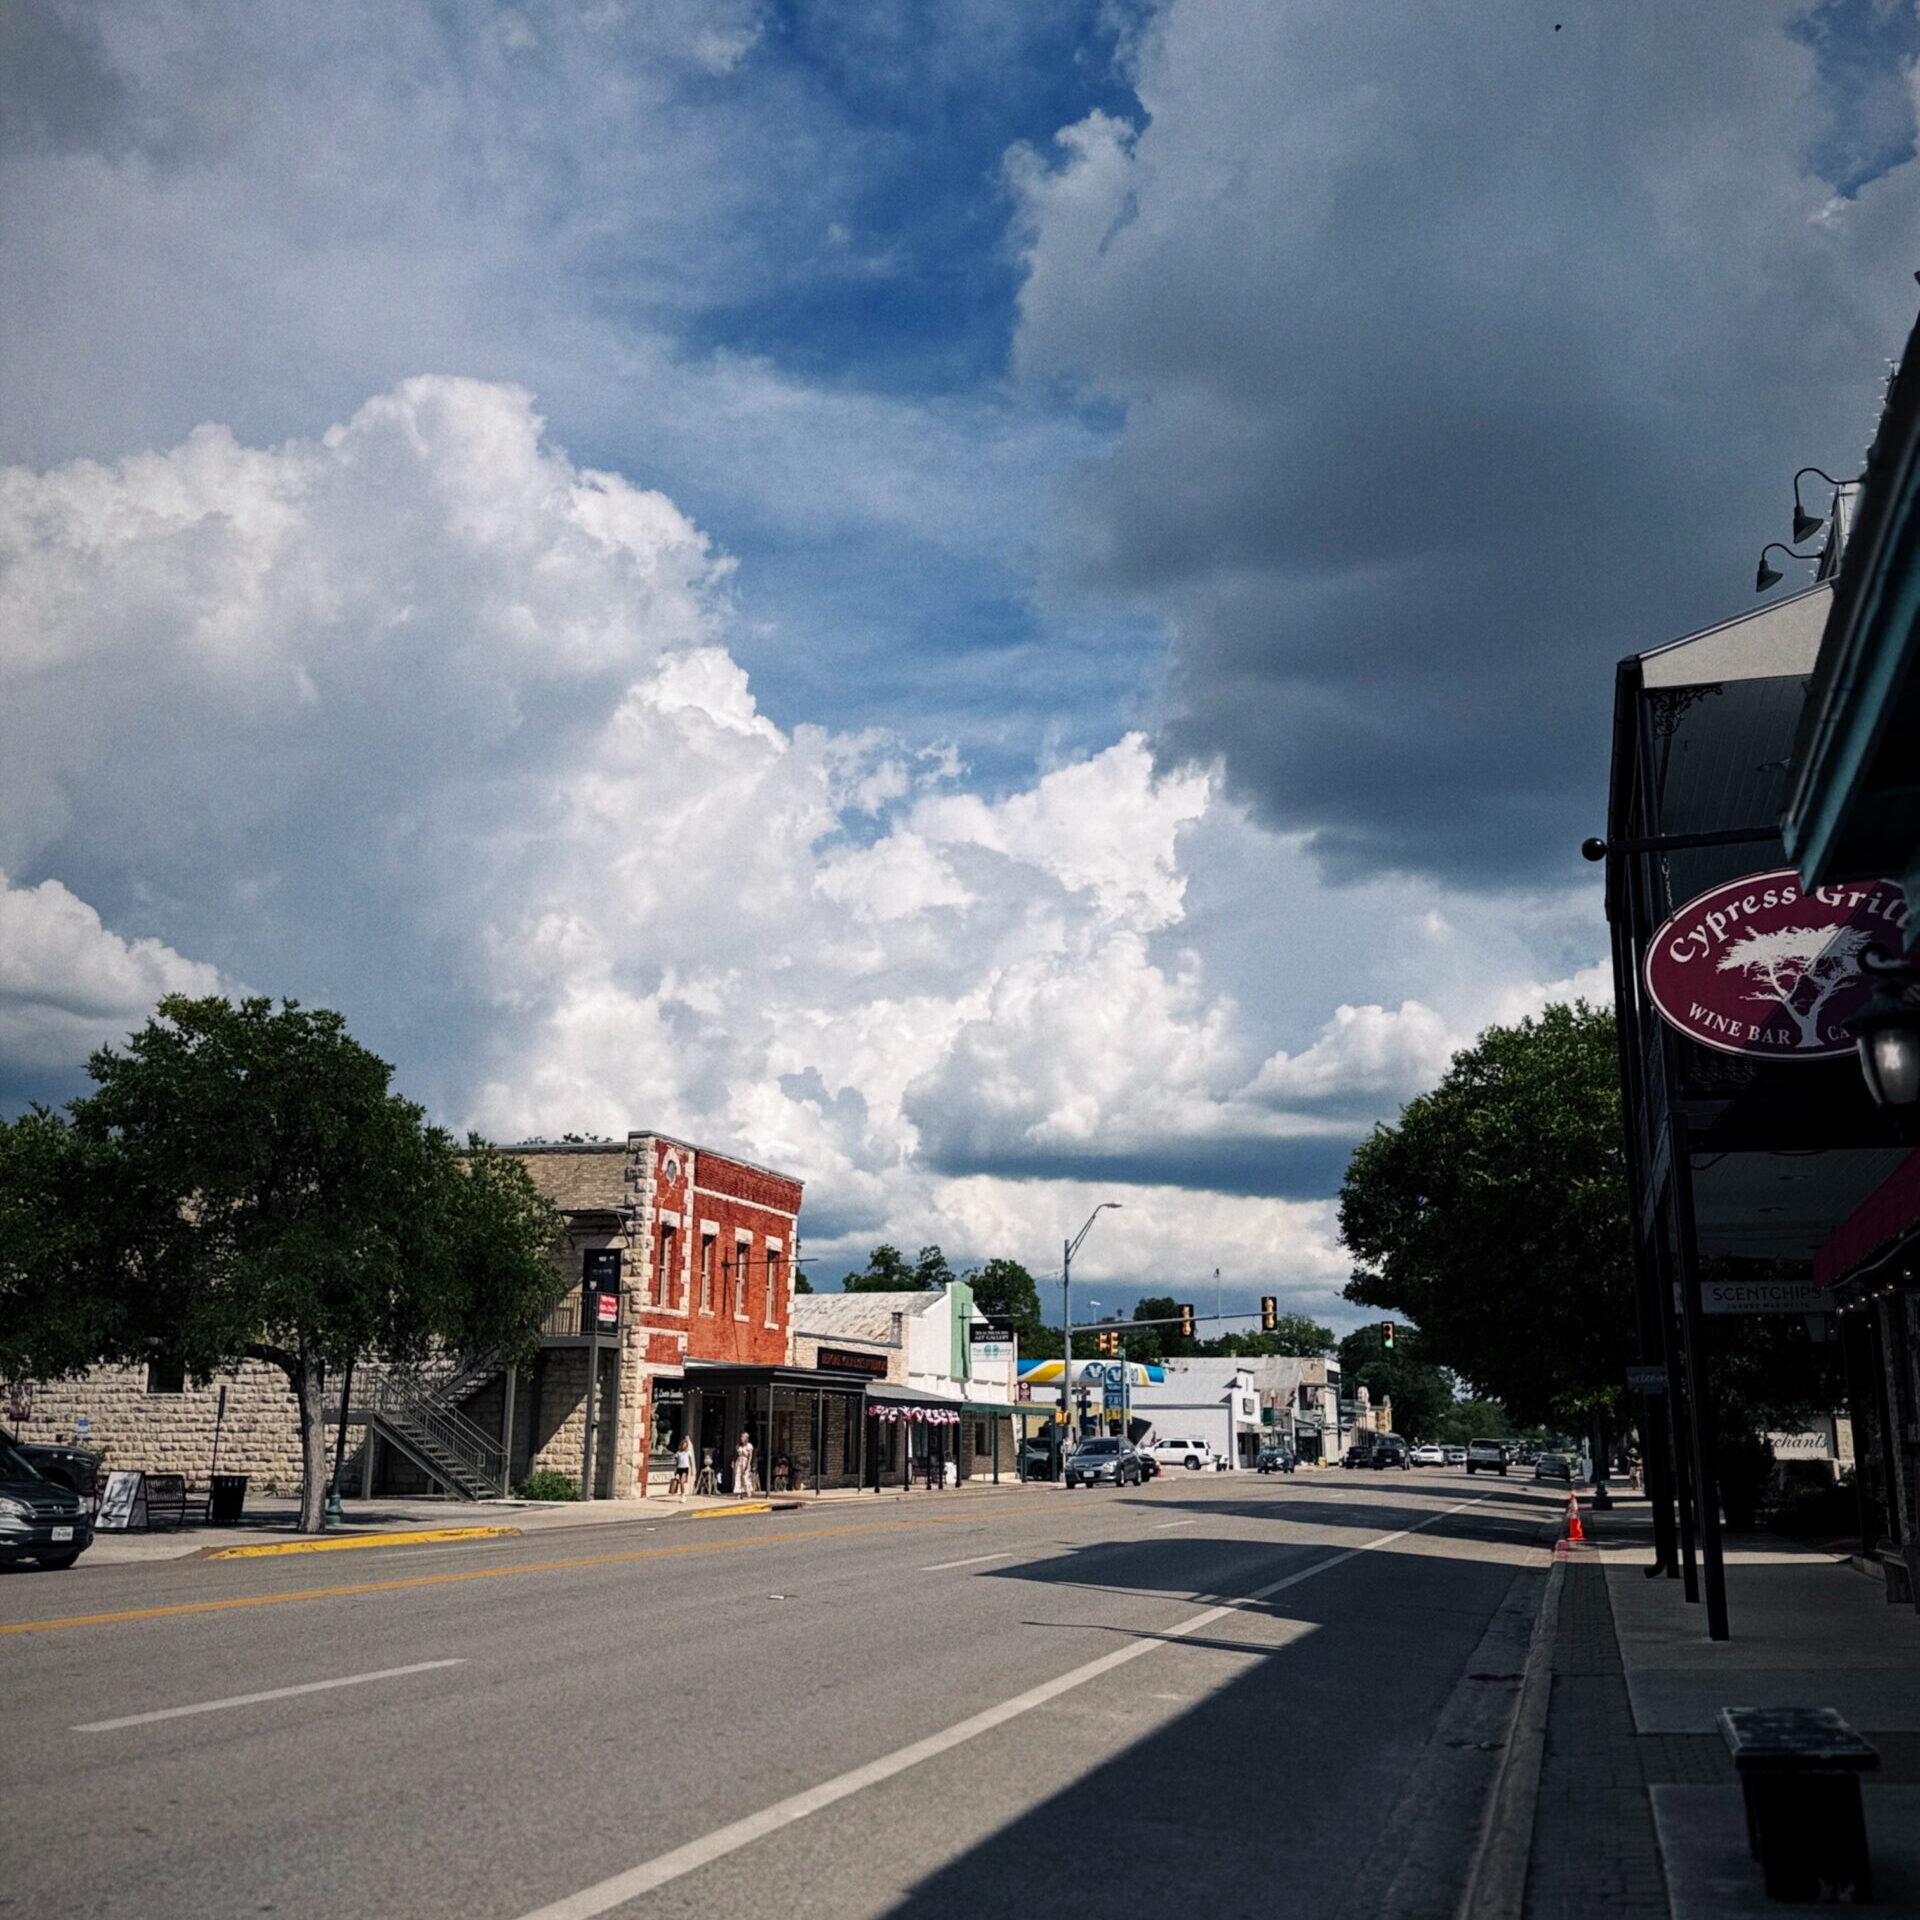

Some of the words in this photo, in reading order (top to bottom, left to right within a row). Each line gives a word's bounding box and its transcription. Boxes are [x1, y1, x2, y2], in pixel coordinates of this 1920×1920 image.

[1669, 886, 1797, 963] Cypress
[1688, 1002, 1743, 1037] WINE
[1748, 1025, 1791, 1045] BAR
